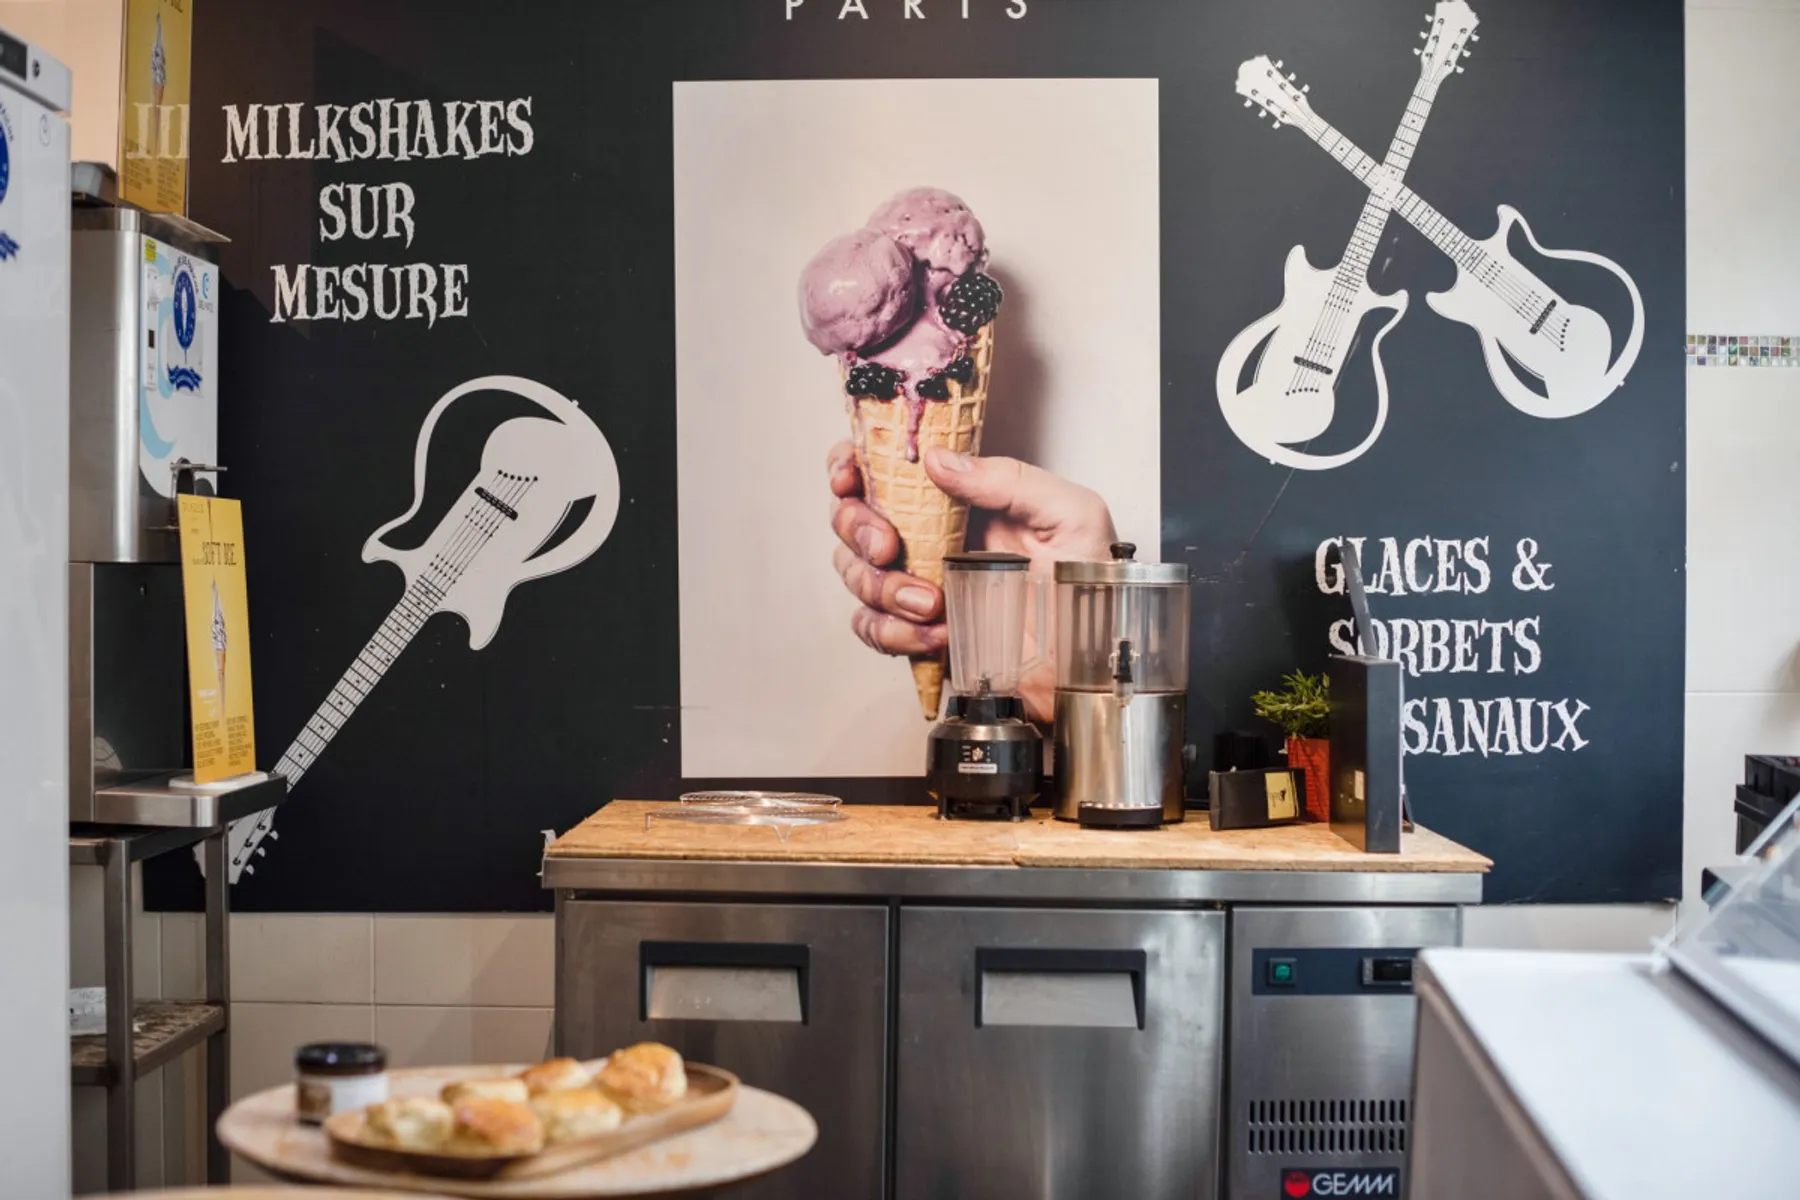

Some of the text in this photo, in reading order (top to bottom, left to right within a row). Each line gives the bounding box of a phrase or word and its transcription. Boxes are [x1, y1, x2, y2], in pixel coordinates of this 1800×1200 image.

[785, 0, 1028, 20] PARIS
[221, 96, 534, 164] MILKSHAKES
[319, 181, 416, 249] SUR
[269, 262, 469, 329] MESURE
[1315, 535, 1556, 597] GLACES &
[1328, 615, 1542, 678] SORBETS
[1402, 696, 1591, 758] SANAUX
[1312, 1173, 1393, 1195] GEMM
